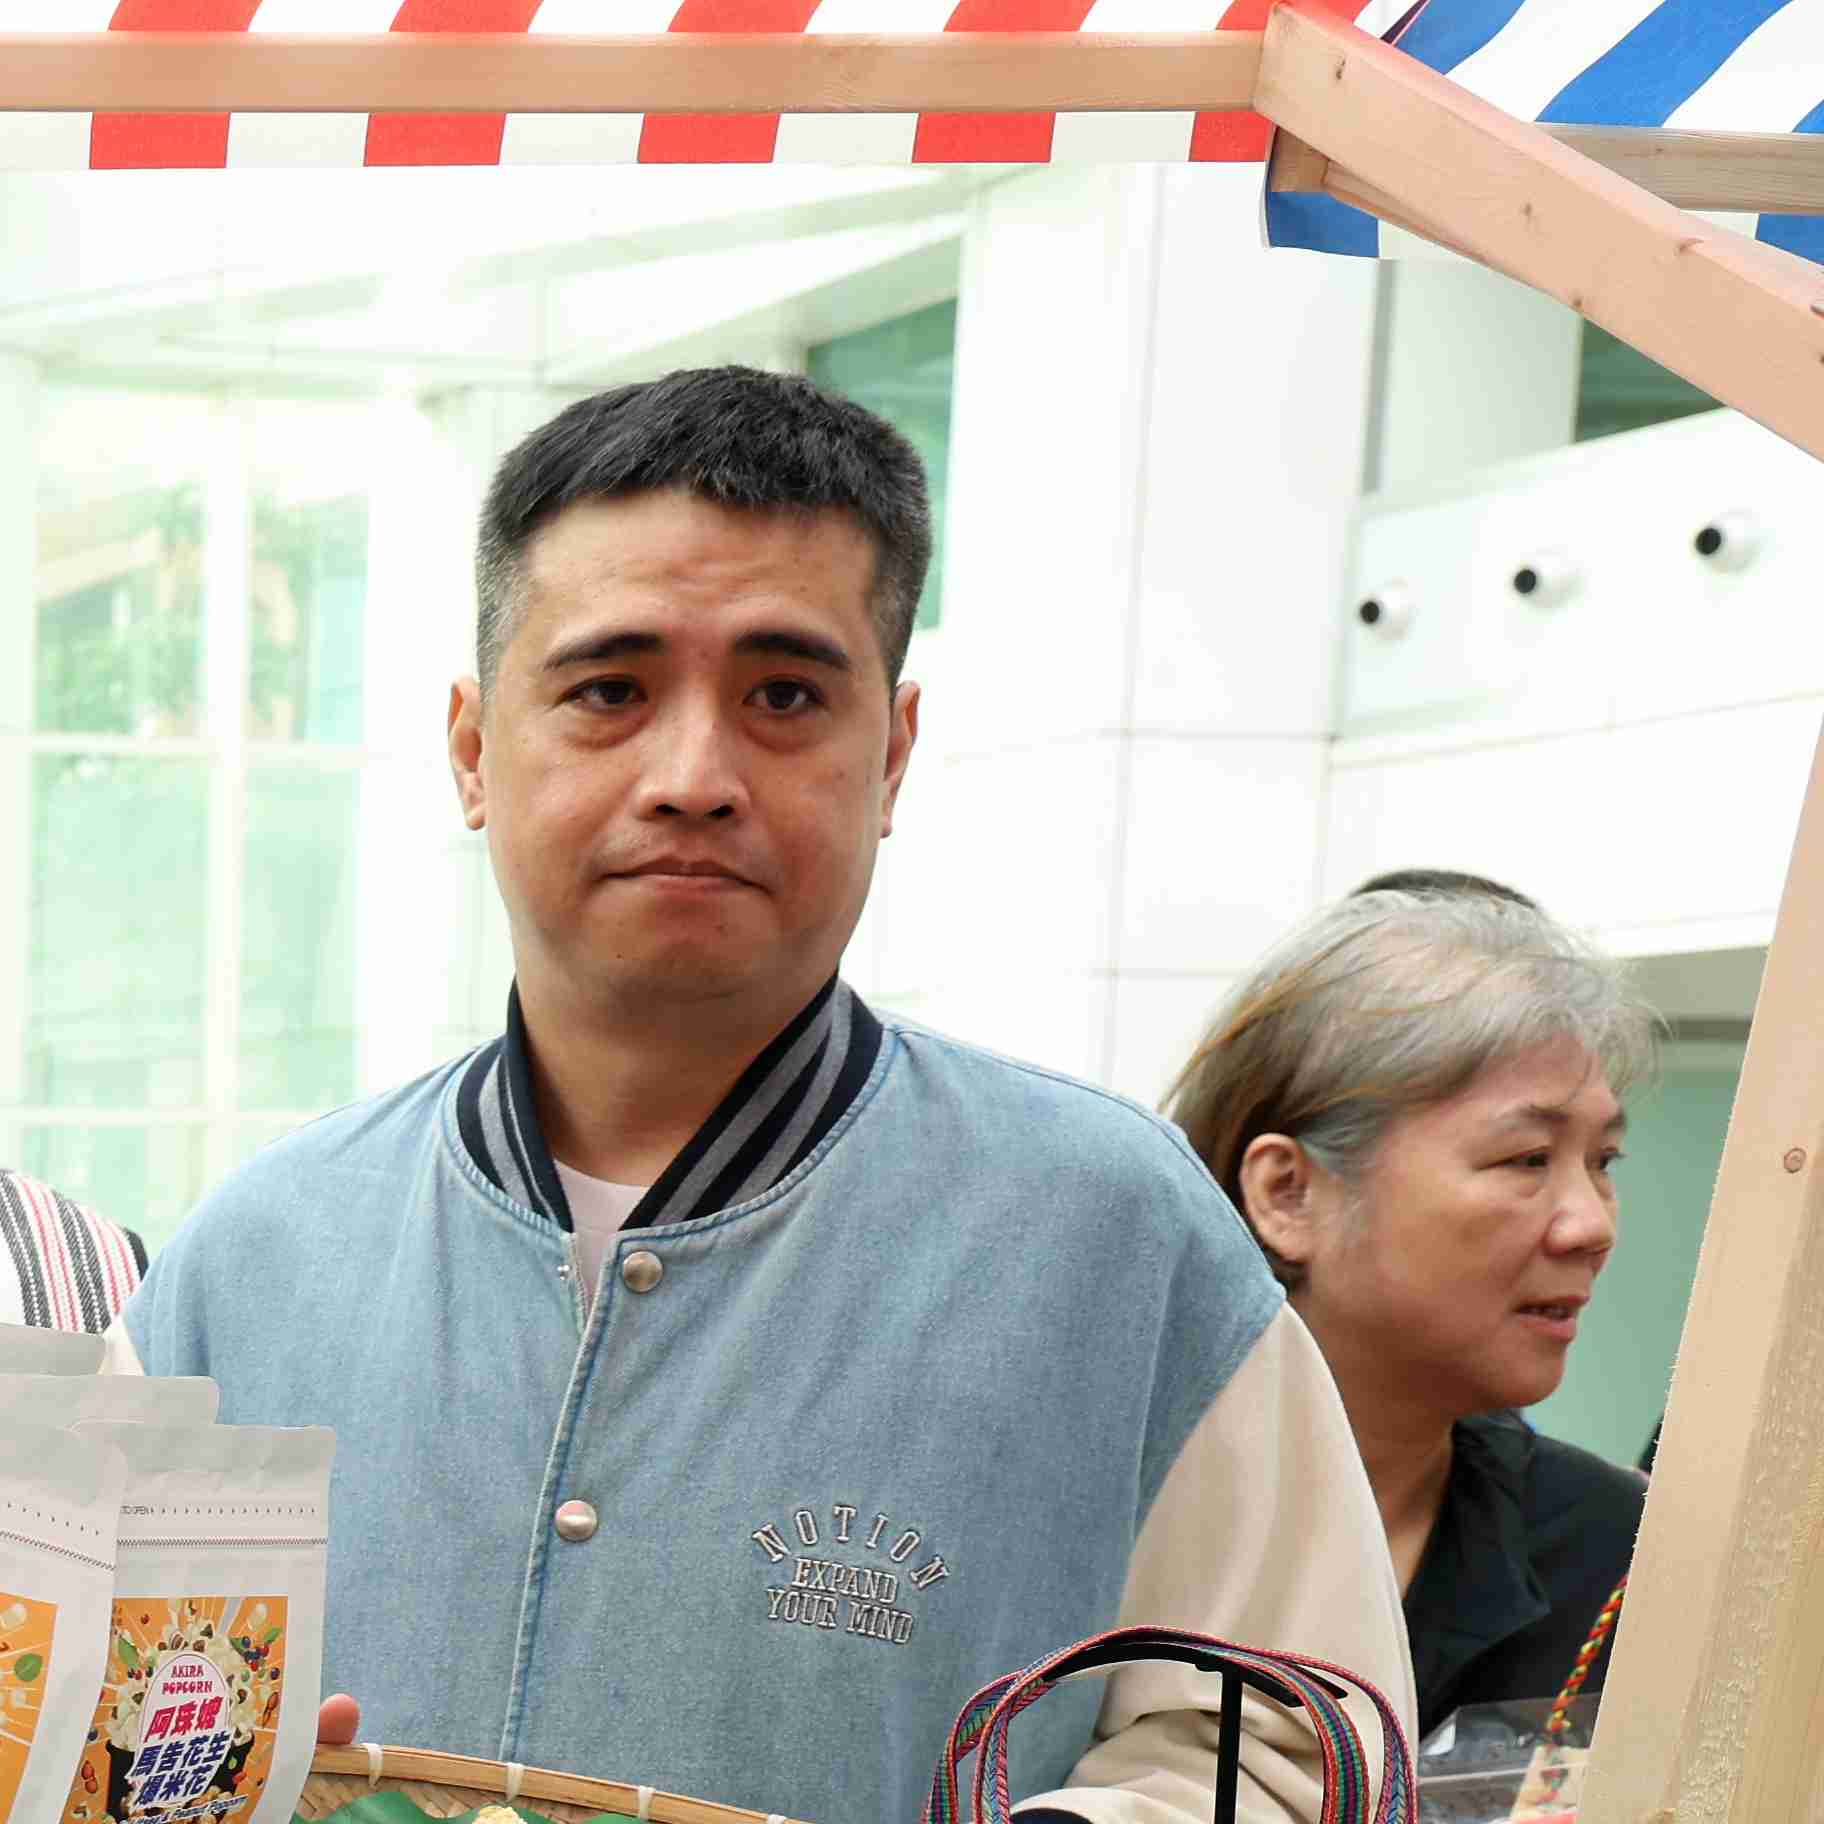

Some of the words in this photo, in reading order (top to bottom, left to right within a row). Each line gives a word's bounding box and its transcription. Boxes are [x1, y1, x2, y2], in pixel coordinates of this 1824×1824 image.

[752, 1505, 950, 1590] NOTION
[792, 1557, 899, 1603] EXPAND
[767, 1588, 839, 1629] YOUR
[846, 1601, 913, 1644] MIND
[162, 1681, 212, 1695] POPCORN
[171, 1665, 204, 1677] AKIRA
[134, 1764, 213, 1807] 爆米花
